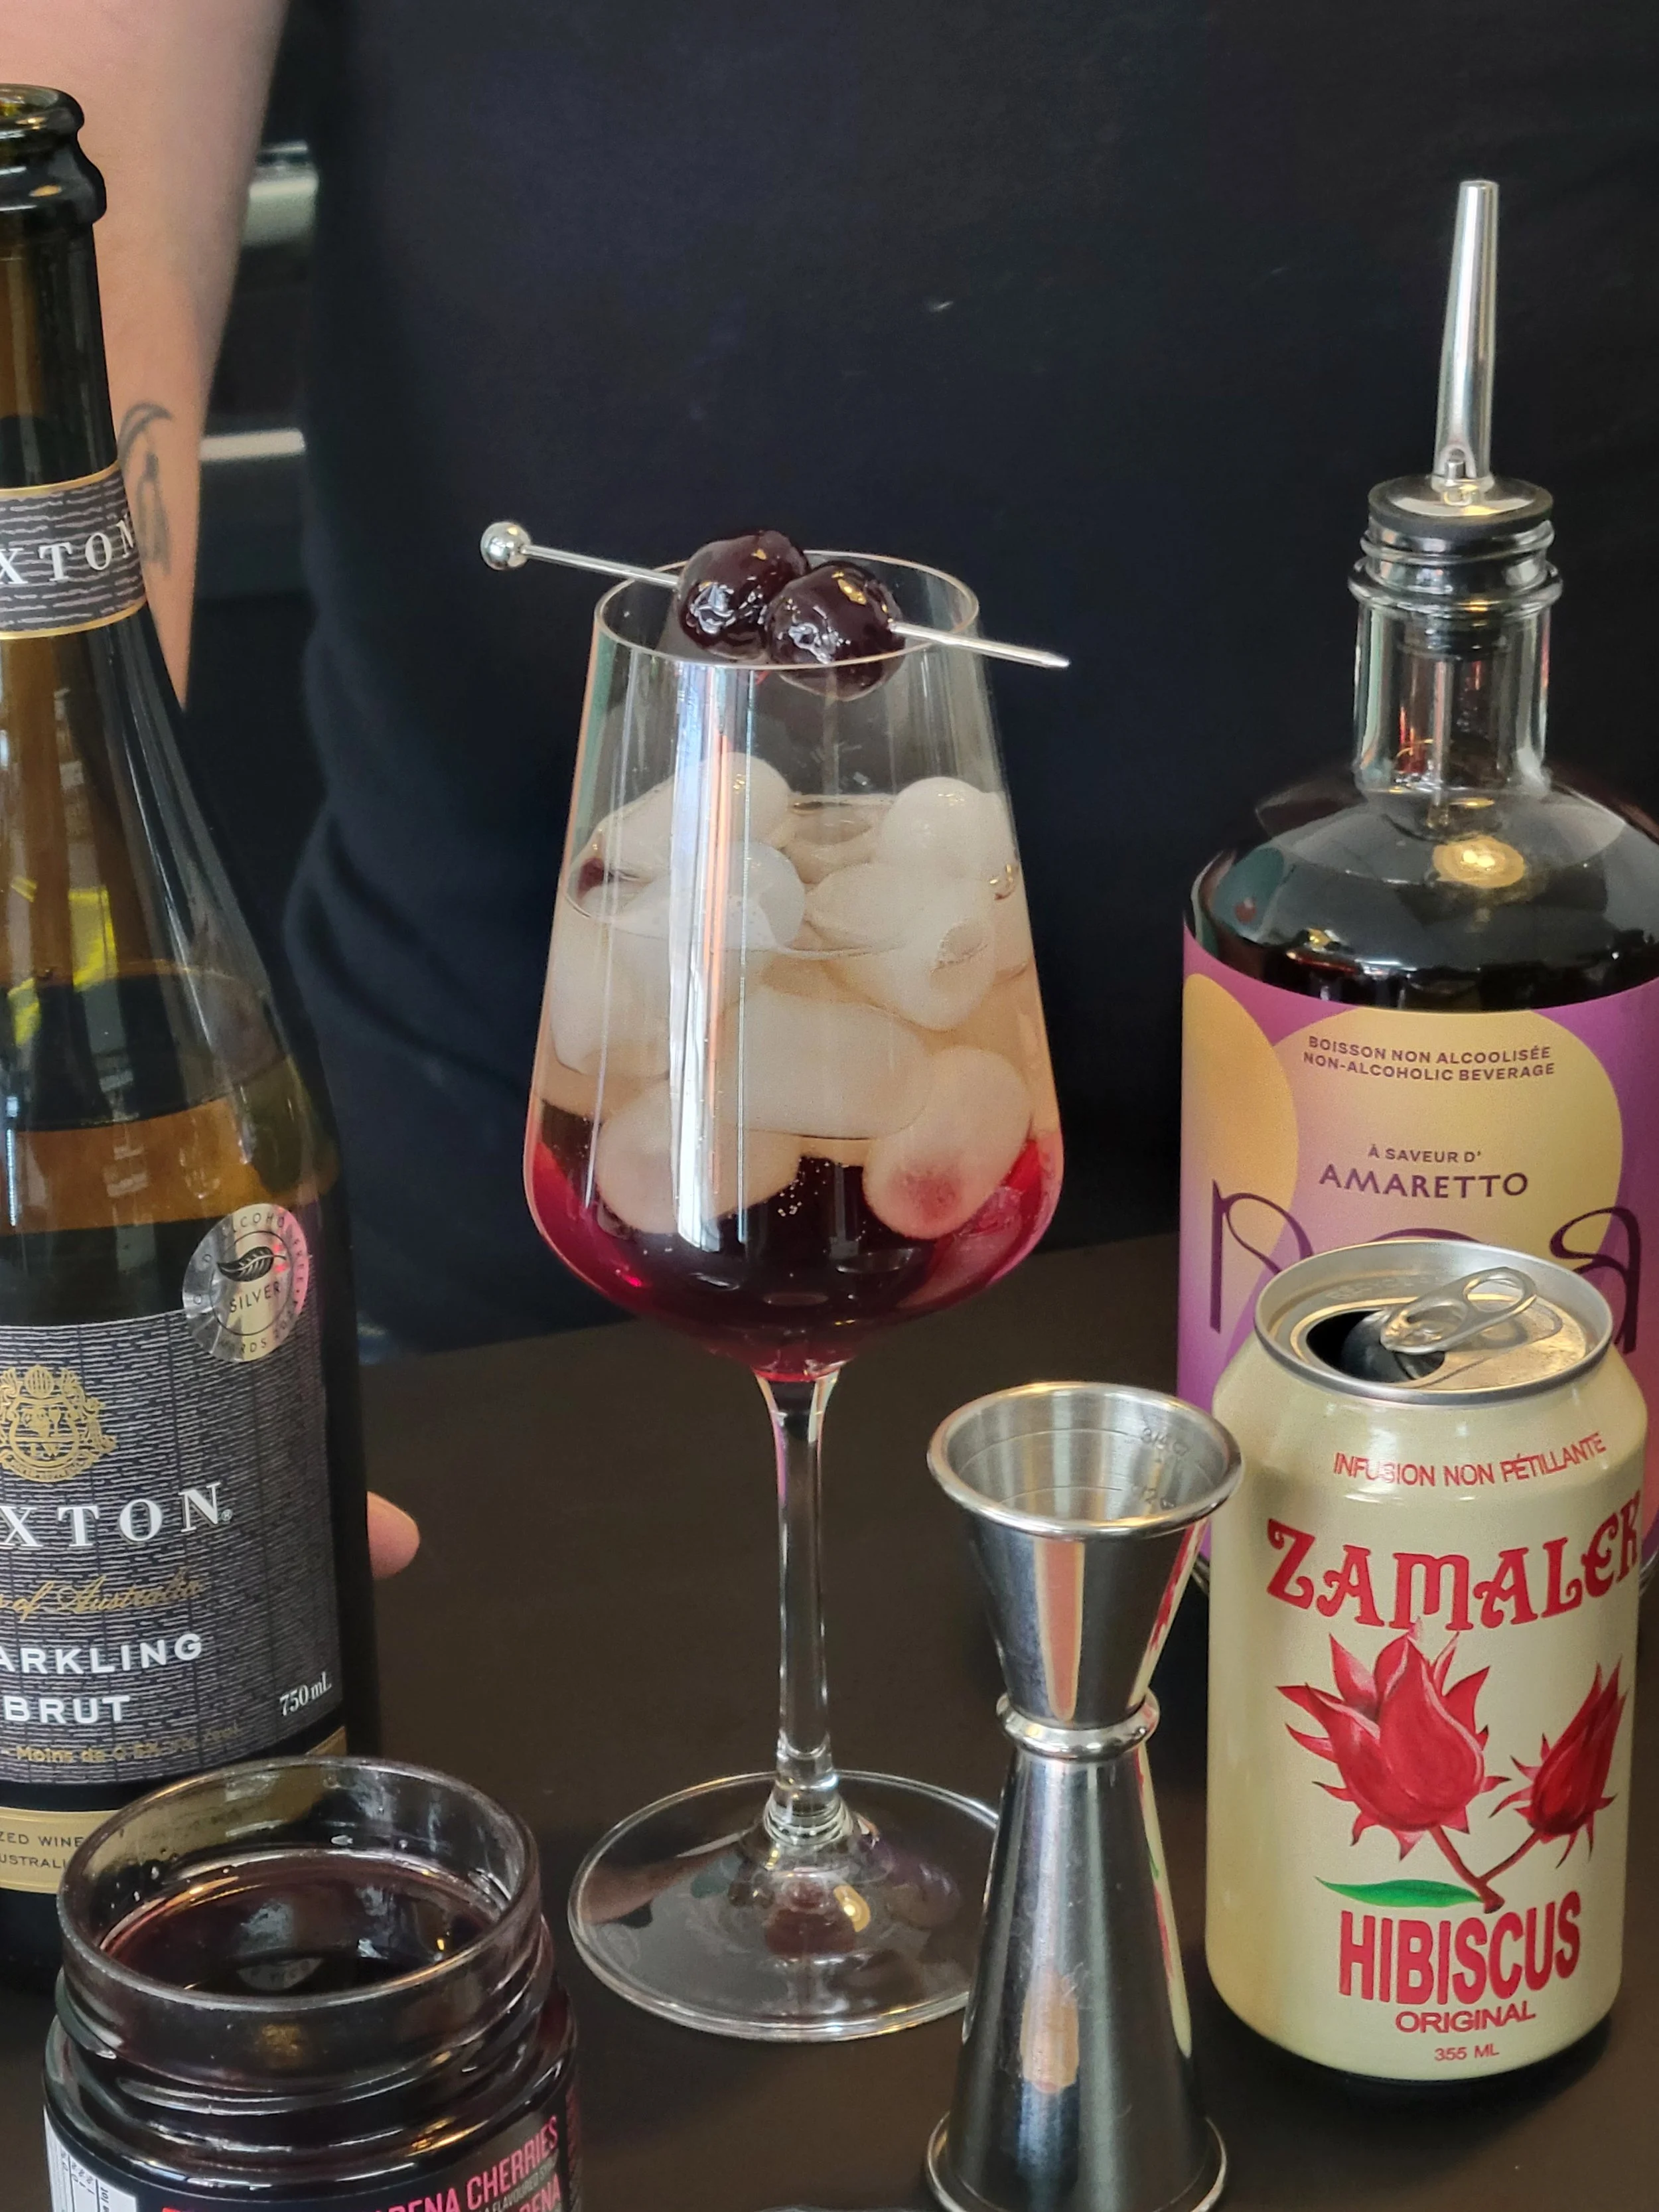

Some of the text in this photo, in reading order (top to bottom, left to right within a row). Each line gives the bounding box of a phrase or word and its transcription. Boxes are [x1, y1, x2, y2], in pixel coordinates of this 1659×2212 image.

[1303, 1051, 1555, 1081] NON-ALCOHOLIC BEVERAGE
[1309, 1035, 1551, 1065] BOISSON NON ALCOOLISÉE
[1368, 1143, 1380, 1159] À
[1385, 1148, 1459, 1163] SAVEUR
[1319, 1163, 1528, 1198] AMARETTO
[228, 1281, 281, 1313] SILVER
[1333, 1432, 1607, 1487] INFUSION NON PÉTILLANTE
[1266, 1489, 1640, 1631] ZAMALEK
[3, 1695, 130, 1724] BRUT
[279, 1684, 309, 1716] 750
[1338, 1890, 1581, 2005] HIBISCUS
[1395, 2000, 1536, 2033] ORIGINAL
[1434, 2042, 1500, 2061] 355 ML
[467, 2115, 557, 2211] CHERRIES
